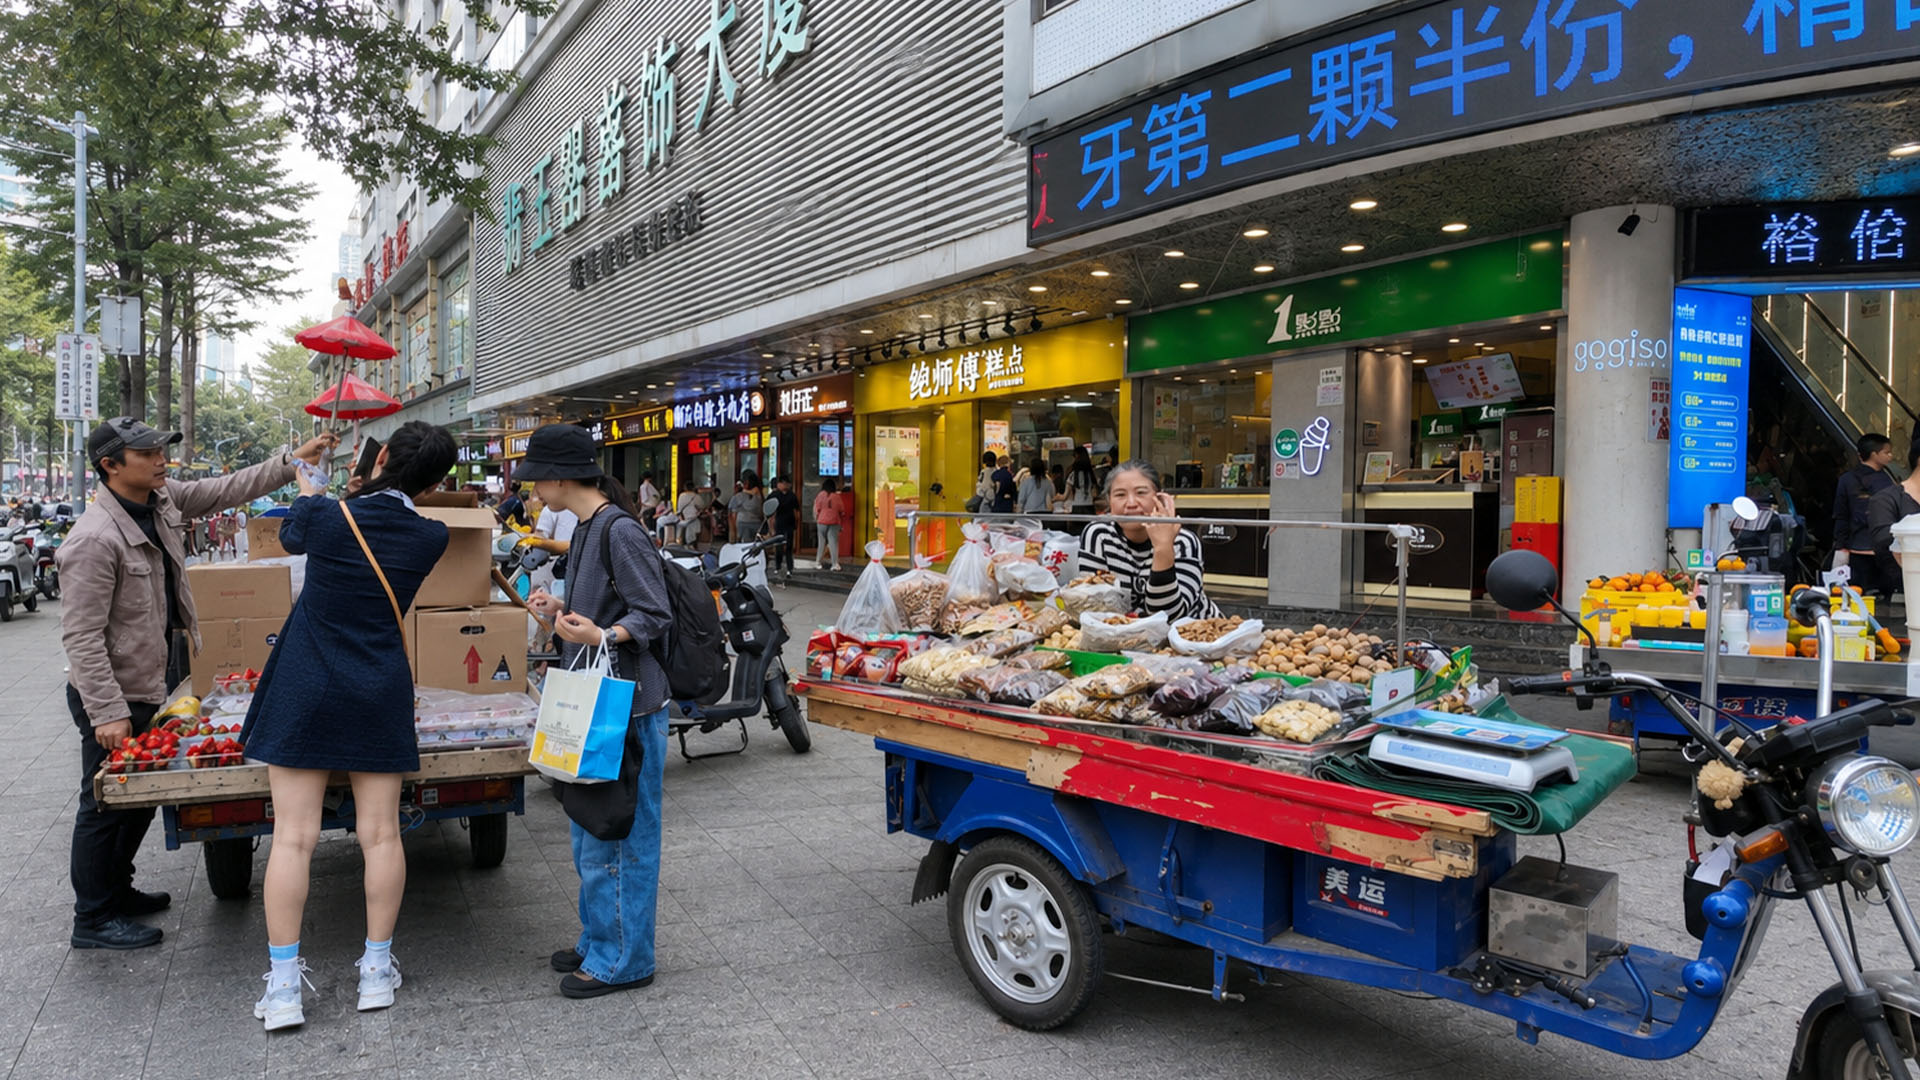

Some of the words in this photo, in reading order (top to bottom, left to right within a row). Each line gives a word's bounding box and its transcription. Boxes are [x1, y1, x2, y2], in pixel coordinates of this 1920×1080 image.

[1077, 0, 1920, 211] 牙第二颗半份，
[1324, 866, 1387, 905] 美运
